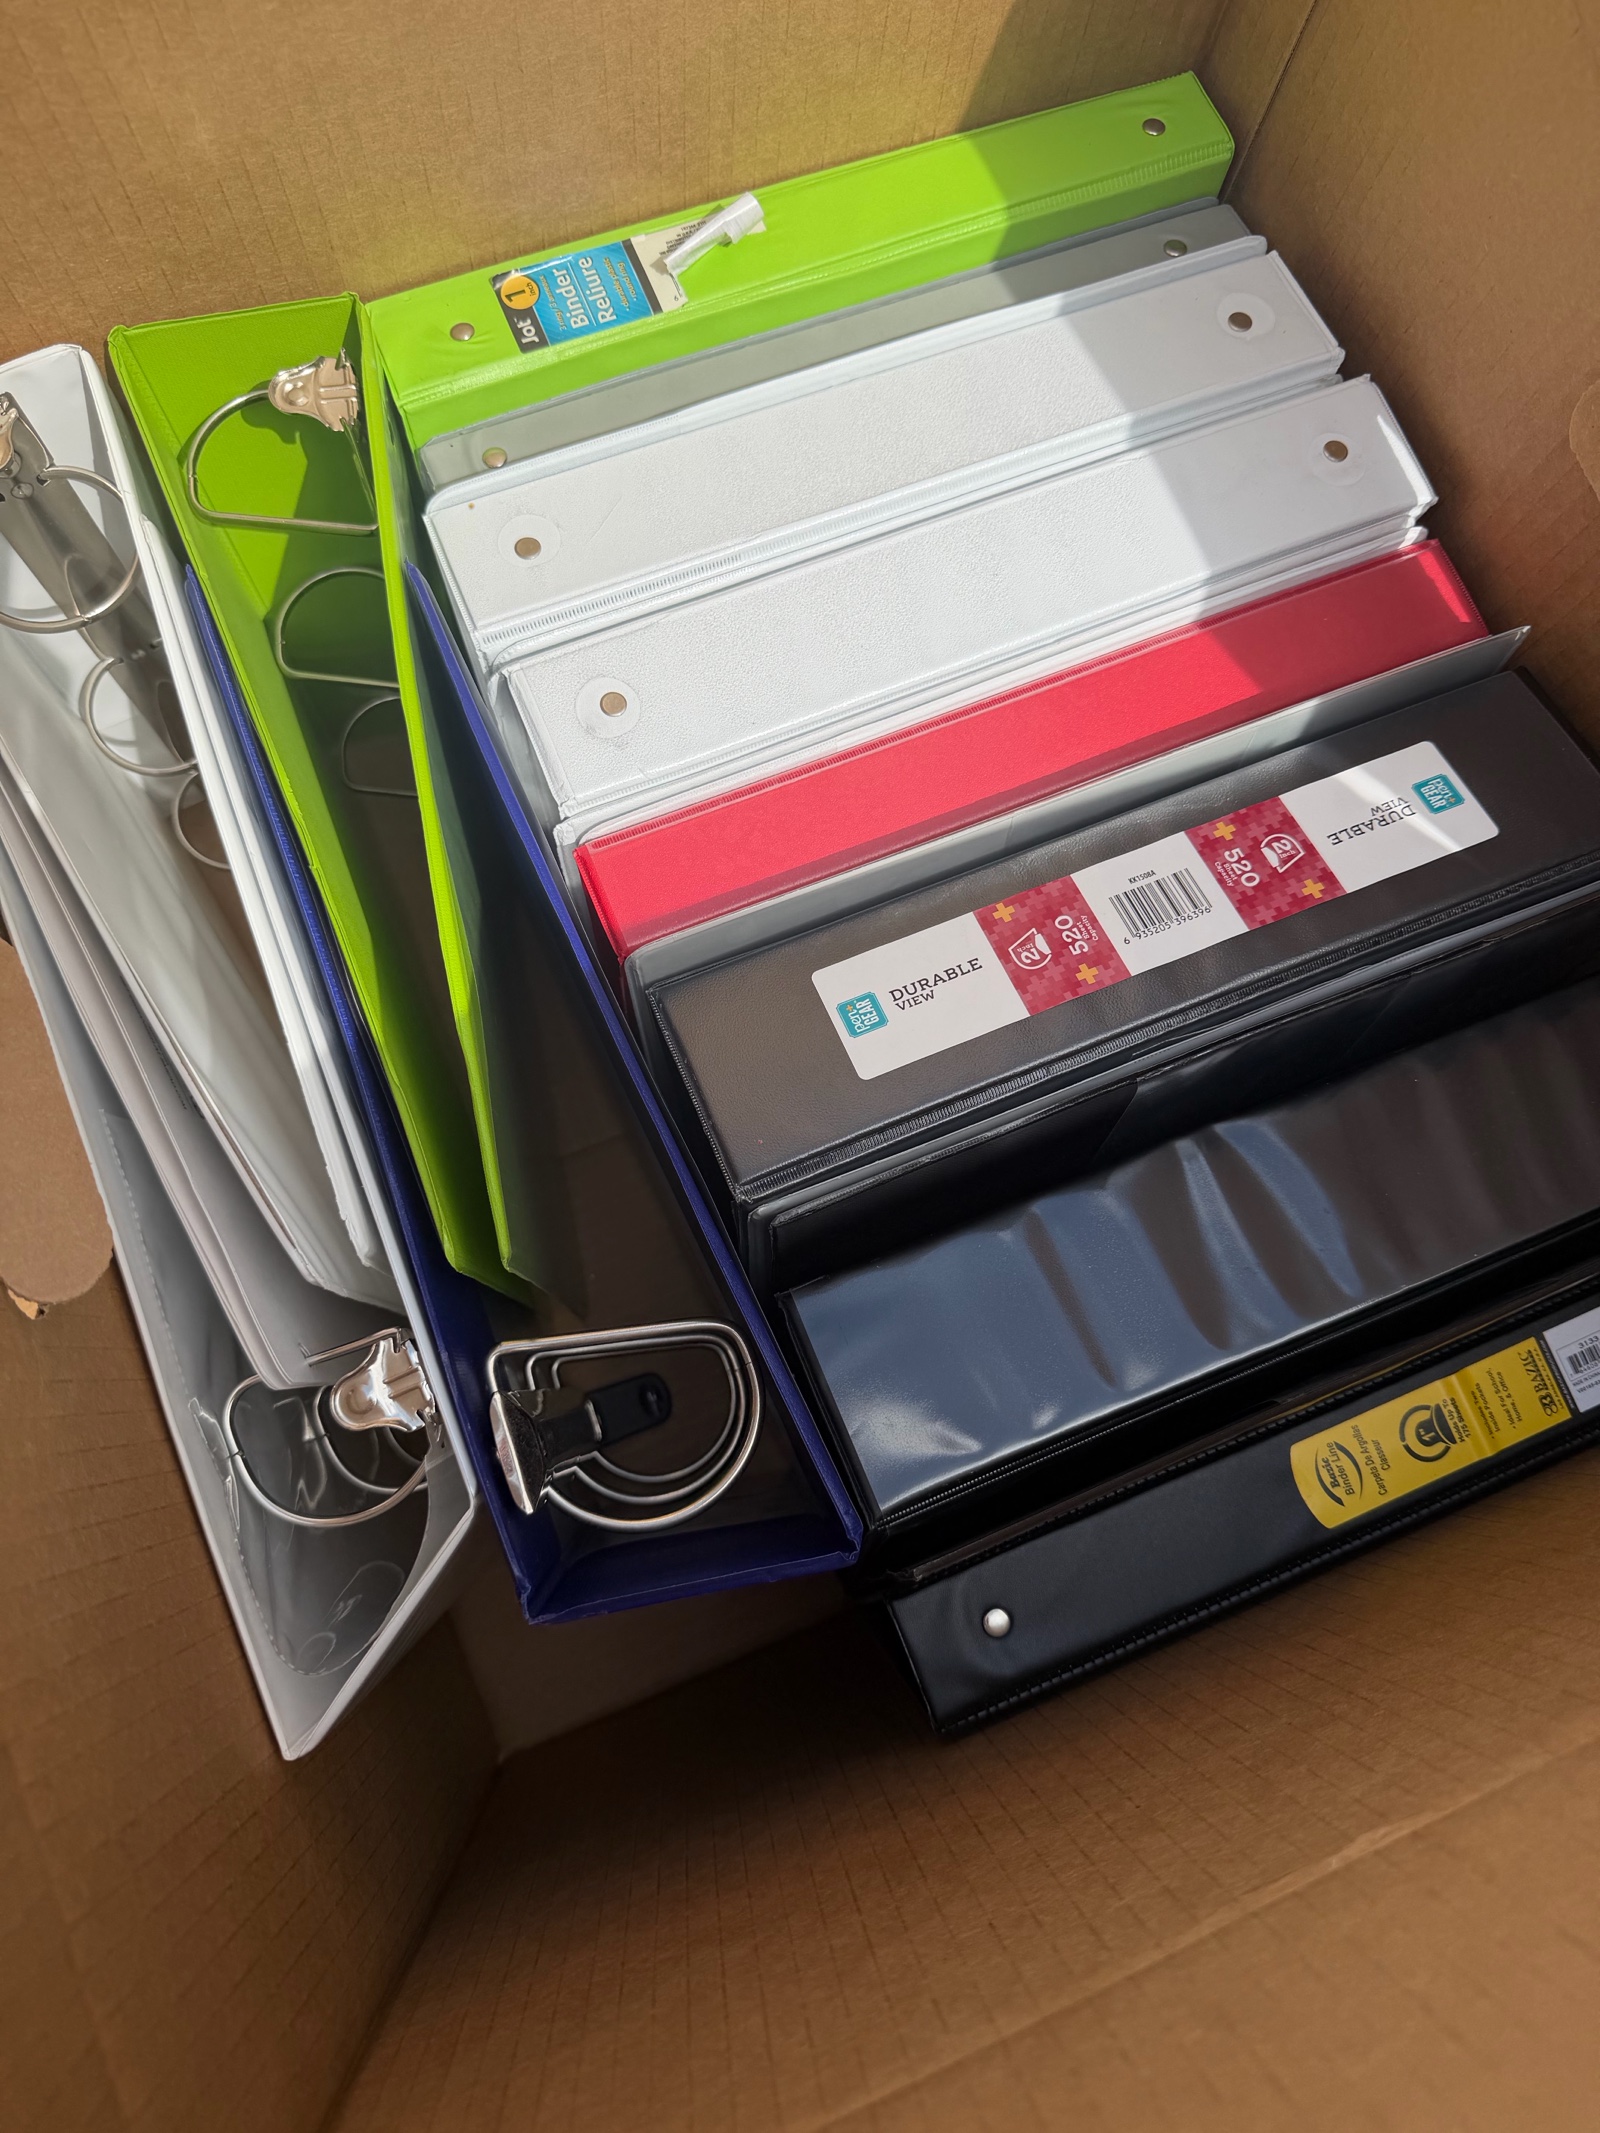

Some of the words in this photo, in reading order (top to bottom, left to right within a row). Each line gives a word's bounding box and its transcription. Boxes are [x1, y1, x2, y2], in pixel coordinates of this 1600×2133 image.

[603, 258, 619, 280] plastic
[617, 262, 627, 276] ring
[505, 289, 526, 302] 1
[526, 282, 536, 295] inch
[579, 257, 616, 323] Reliure
[613, 280, 629, 307] durable
[622, 276, 636, 297] round
[553, 269, 589, 328] Binder
[555, 311, 564, 325] ring
[517, 319, 539, 343] Jot
[1370, 797, 1408, 816] VIEW
[1421, 785, 1447, 809] GEAR
[1327, 804, 1417, 846] DURABLE
[1271, 839, 1292, 854] 2
[1128, 869, 1156, 885] KK1508A
[1223, 863, 1239, 881] Sheet
[1224, 847, 1260, 887] 520
[1055, 915, 1089, 956] 520
[1076, 921, 1090, 940] Sheet
[1123, 936, 1131, 945] 6
[1135, 921, 1172, 940] 935205
[1173, 905, 1212, 926] 396396
[1020, 947, 1041, 964] 2
[889, 957, 983, 1002] DURABLE
[895, 990, 935, 1011] VIEW
[857, 998, 880, 1026] GEAR
[1578, 1335, 1600, 1349] 3133
[1486, 1367, 1501, 1394] School,
[1497, 1372, 1508, 1392] Office
[1520, 1352, 1544, 1393] BAZIC
[1442, 1399, 1449, 1409] To
[1471, 1391, 1479, 1405] Two
[1475, 1383, 1490, 1410] Pockets
[1498, 1396, 1507, 1407] For
[1447, 1409, 1455, 1421] Up
[1450, 1397, 1465, 1423] Sheets
[1478, 1406, 1493, 1435] Includes
[1504, 1408, 1515, 1425] Ideal
[1511, 1399, 1522, 1422] Home,
[1453, 1421, 1465, 1443] Holds
[1461, 1424, 1471, 1438] 175
[1488, 1411, 1500, 1432] Inside
[1351, 1425, 1370, 1454] Argollas
[1327, 1442, 1340, 1463] Line
[1365, 1455, 1375, 1466] De
[1371, 1440, 1391, 1471] Classeur
[1322, 1458, 1341, 1488] Bazic
[1335, 1465, 1355, 1496] Binder
[1370, 1466, 1388, 1496] Carpeta
